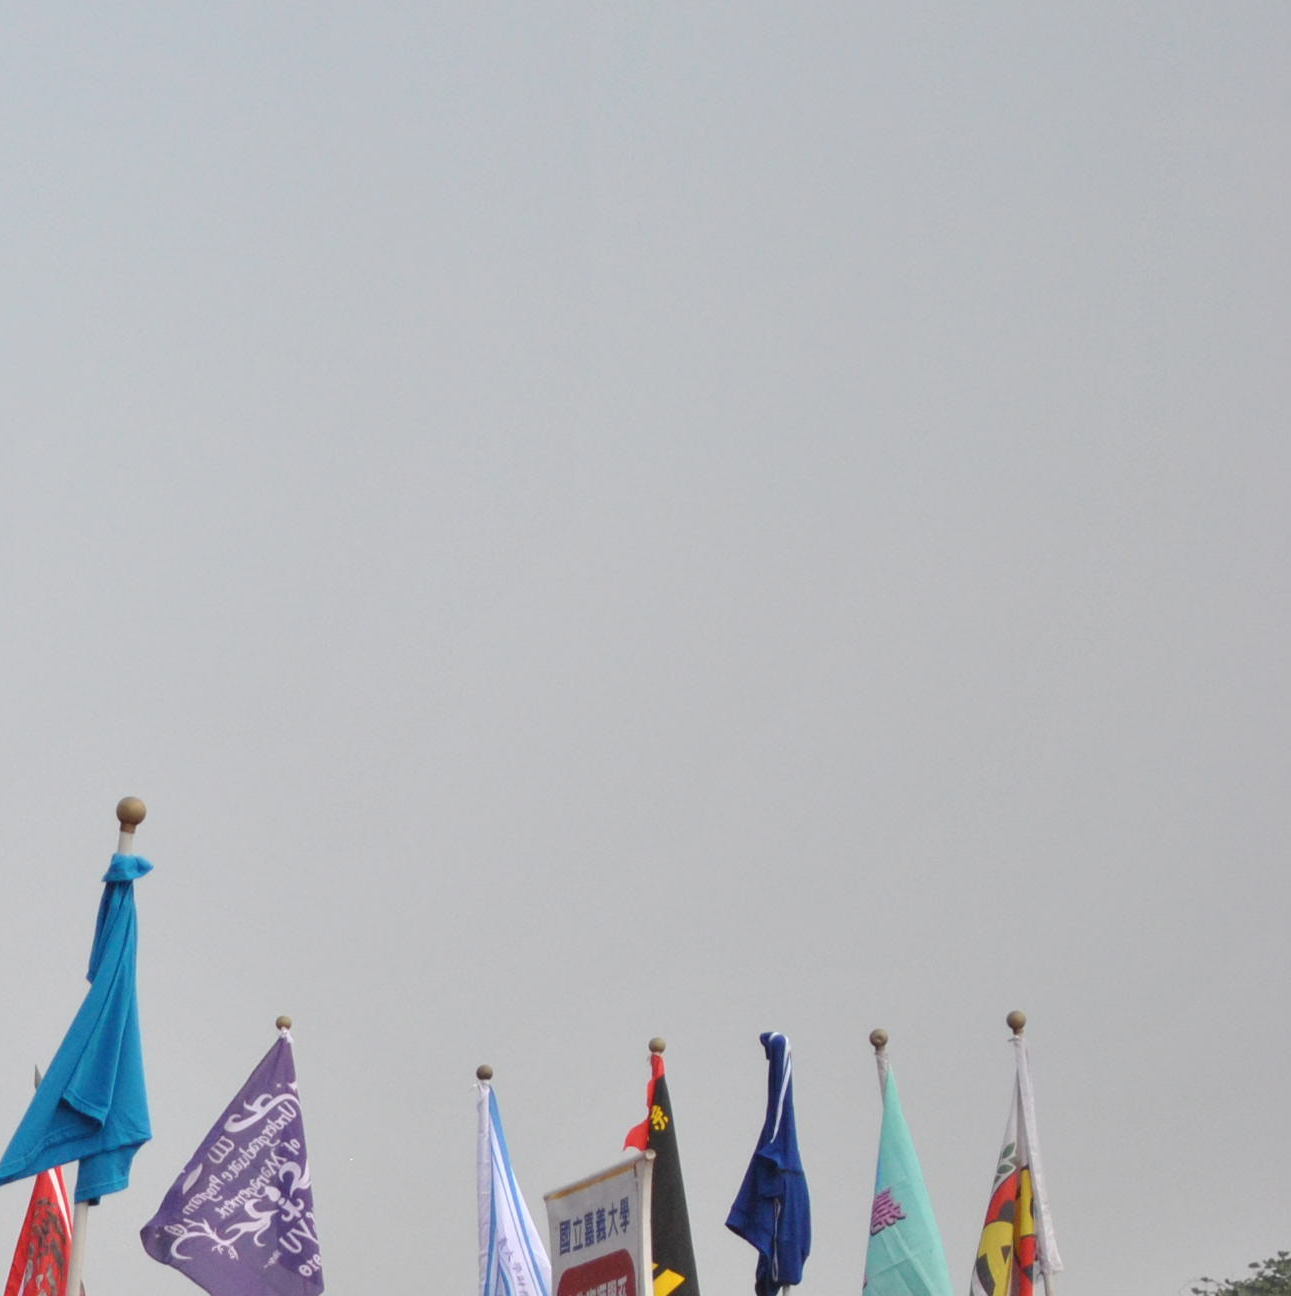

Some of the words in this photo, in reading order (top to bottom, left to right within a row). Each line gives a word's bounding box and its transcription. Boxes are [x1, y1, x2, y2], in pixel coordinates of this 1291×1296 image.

[559, 1196, 630, 1256] 國立嘉義大學
